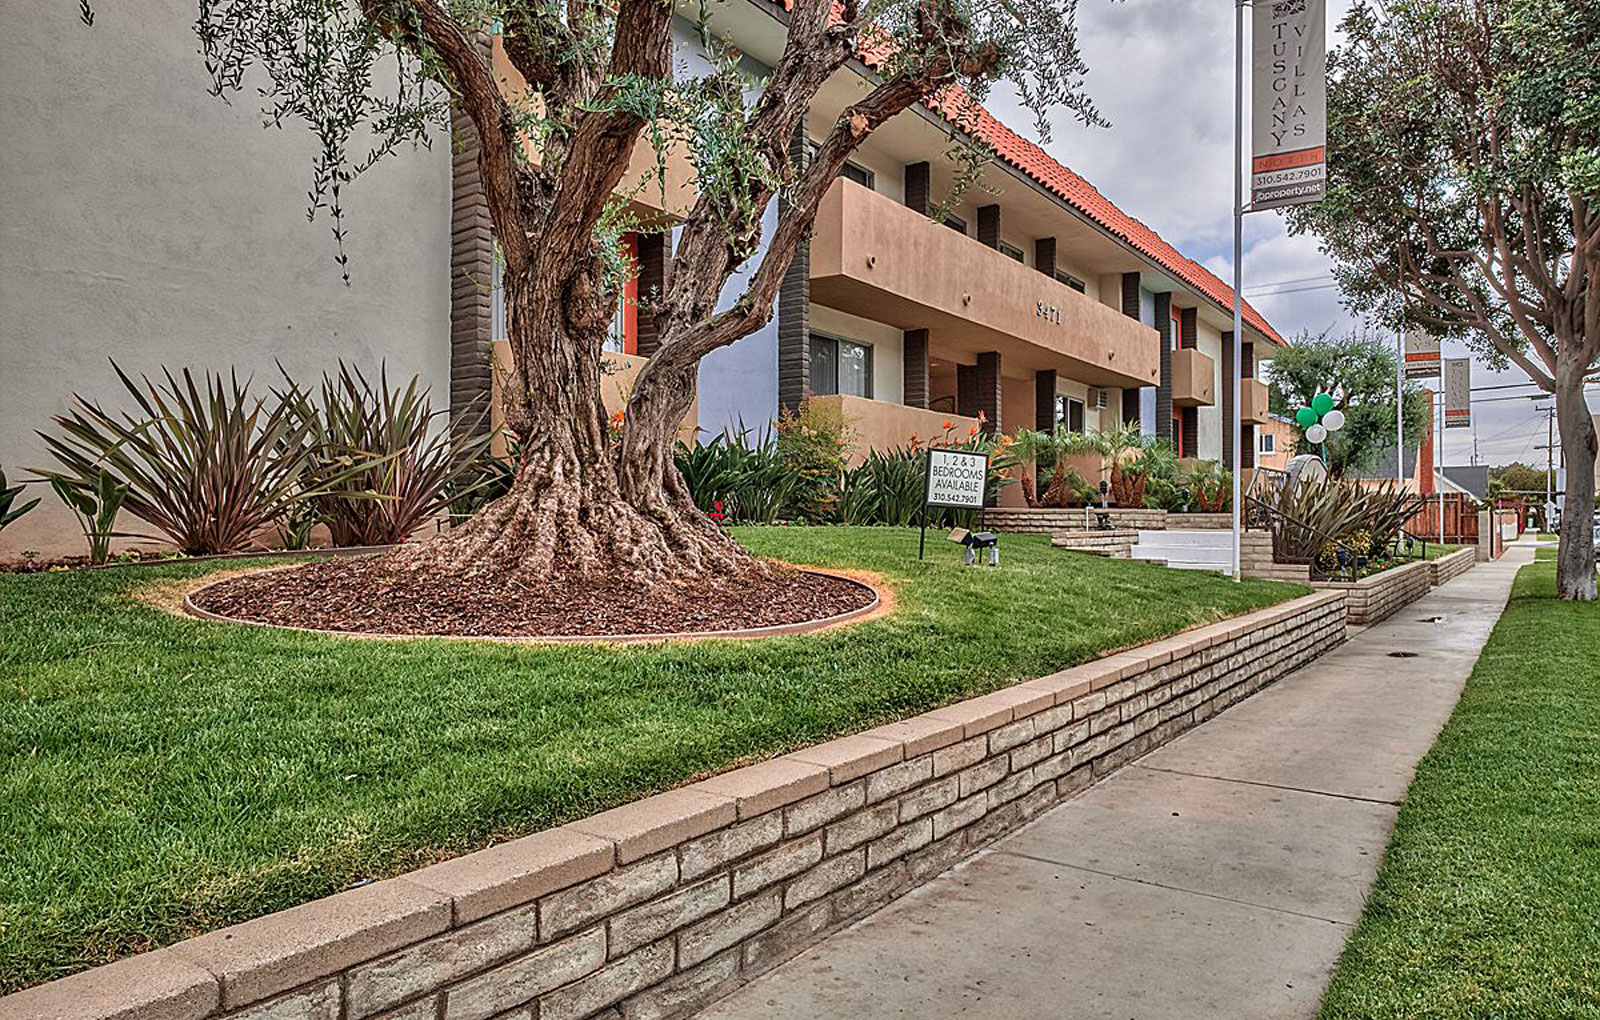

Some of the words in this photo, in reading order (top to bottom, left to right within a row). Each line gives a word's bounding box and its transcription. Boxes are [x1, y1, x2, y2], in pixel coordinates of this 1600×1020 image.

[1271, 22, 1287, 147] TUSCANY
[1293, 25, 1307, 137] VILLAS
[1256, 167, 1322, 186] 310.542.7901
[1036, 299, 1061, 326] 3471
[952, 455, 959, 466] 2
[960, 456, 968, 467] &
[969, 457, 976, 468] 3
[932, 465, 984, 481] BEDROOMS
[934, 478, 979, 493] AVAILABLE
[933, 492, 977, 504] 310.542.7901
